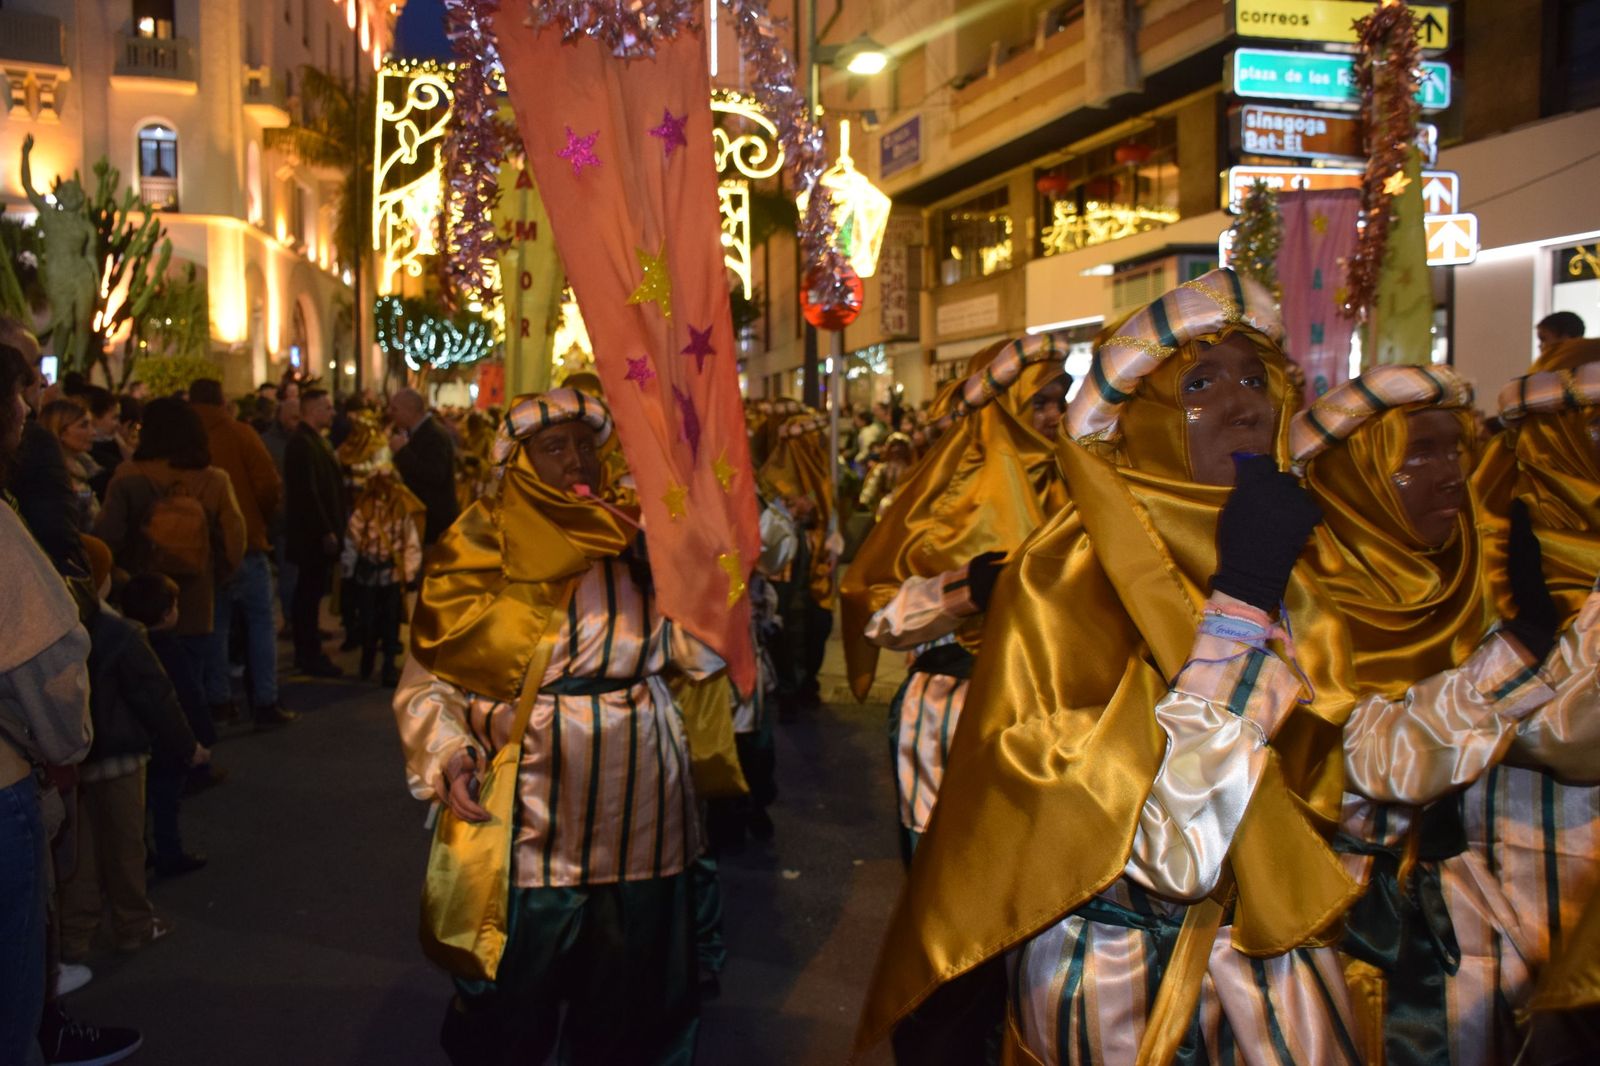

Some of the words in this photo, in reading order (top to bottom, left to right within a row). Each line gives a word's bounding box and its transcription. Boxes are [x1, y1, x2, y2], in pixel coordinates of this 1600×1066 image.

[1240, 12, 1310, 26] correos
[1239, 67, 1277, 82] plaza
[1284, 70, 1304, 84] de
[1309, 70, 1331, 85] los
[1246, 112, 1327, 136] sinagoga
[515, 170, 537, 338] AMOR
